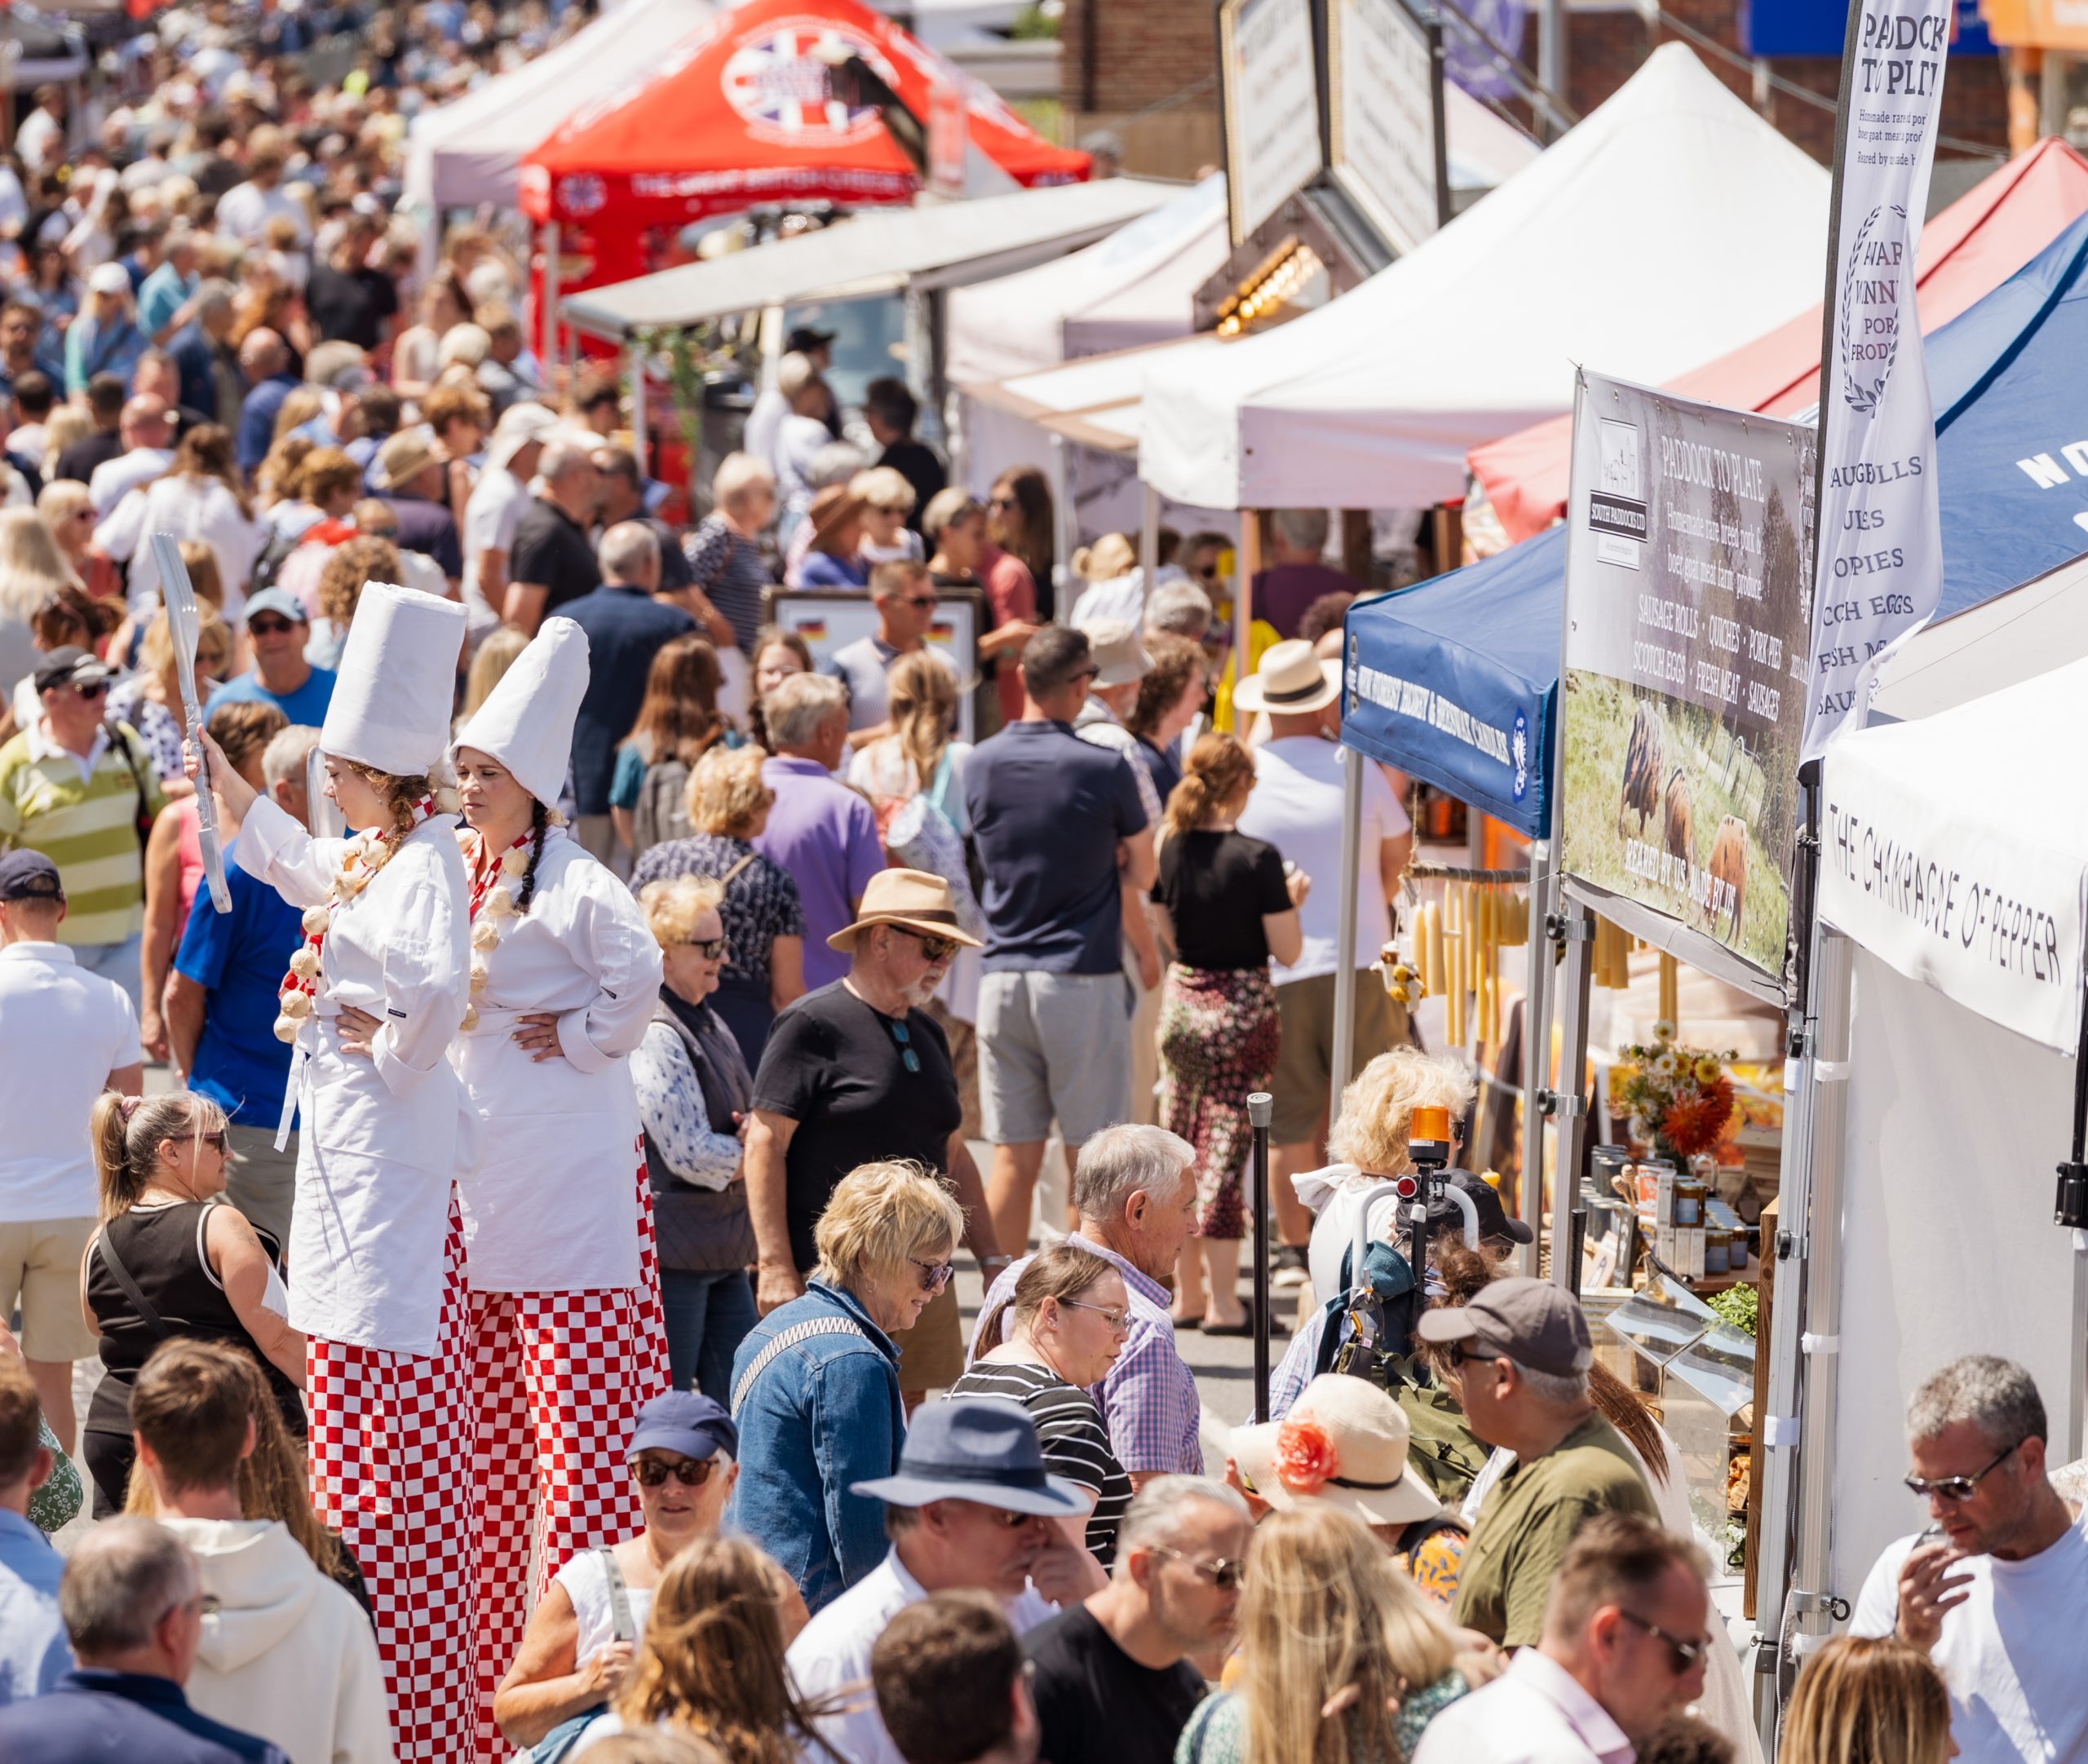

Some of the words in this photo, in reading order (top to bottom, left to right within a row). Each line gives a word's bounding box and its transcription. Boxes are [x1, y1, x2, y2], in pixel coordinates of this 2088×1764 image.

[1878, 152, 1888, 167] by
[1661, 435, 1714, 489] PADDOCK
[1714, 448, 1730, 493] TO
[1731, 453, 1764, 503] PLATE
[1591, 502, 1611, 523] SOUTH
[1611, 506, 1636, 528] PADDOCKS
[1636, 512, 1646, 531] LTD
[1667, 502, 1704, 538] Homemade
[1705, 519, 1719, 542] rare
[1720, 515, 1739, 548] breed
[1740, 524, 1755, 555] pork
[1757, 527, 1762, 555] &
[1668, 544, 1683, 576] boer
[1683, 555, 1698, 583] goat
[1701, 560, 1716, 585] meat
[1718, 559, 1733, 591] farm
[1639, 594, 1674, 630] SAUSAGE
[1675, 603, 1698, 639] ROLLS
[1709, 615, 1741, 653] QUICHES
[1749, 628, 1768, 665] PORK
[1768, 635, 1783, 671] PIES
[1633, 641, 1665, 678] SCOTCH
[1666, 652, 1687, 685] EGGS
[1696, 661, 1720, 698] FRESH
[1719, 669, 1741, 705] MEAT
[1748, 680, 1781, 723] SAUSAGES
[1399, 680, 1430, 722] HONEY
[1428, 691, 1436, 726] &
[1471, 718, 1510, 766] CANDLES
[1625, 838, 1659, 882] REARED
[1661, 851, 1673, 887] BY
[1674, 856, 1687, 893] US
[1688, 864, 1713, 909] MADE
[1712, 876, 1726, 914] BY
[1724, 882, 1737, 920] US
[1830, 803, 1858, 882] THE
[1863, 826, 1960, 939] CHAMPAGNE
[1962, 882, 1991, 953] OF
[1989, 894, 2061, 986] PEPPER
